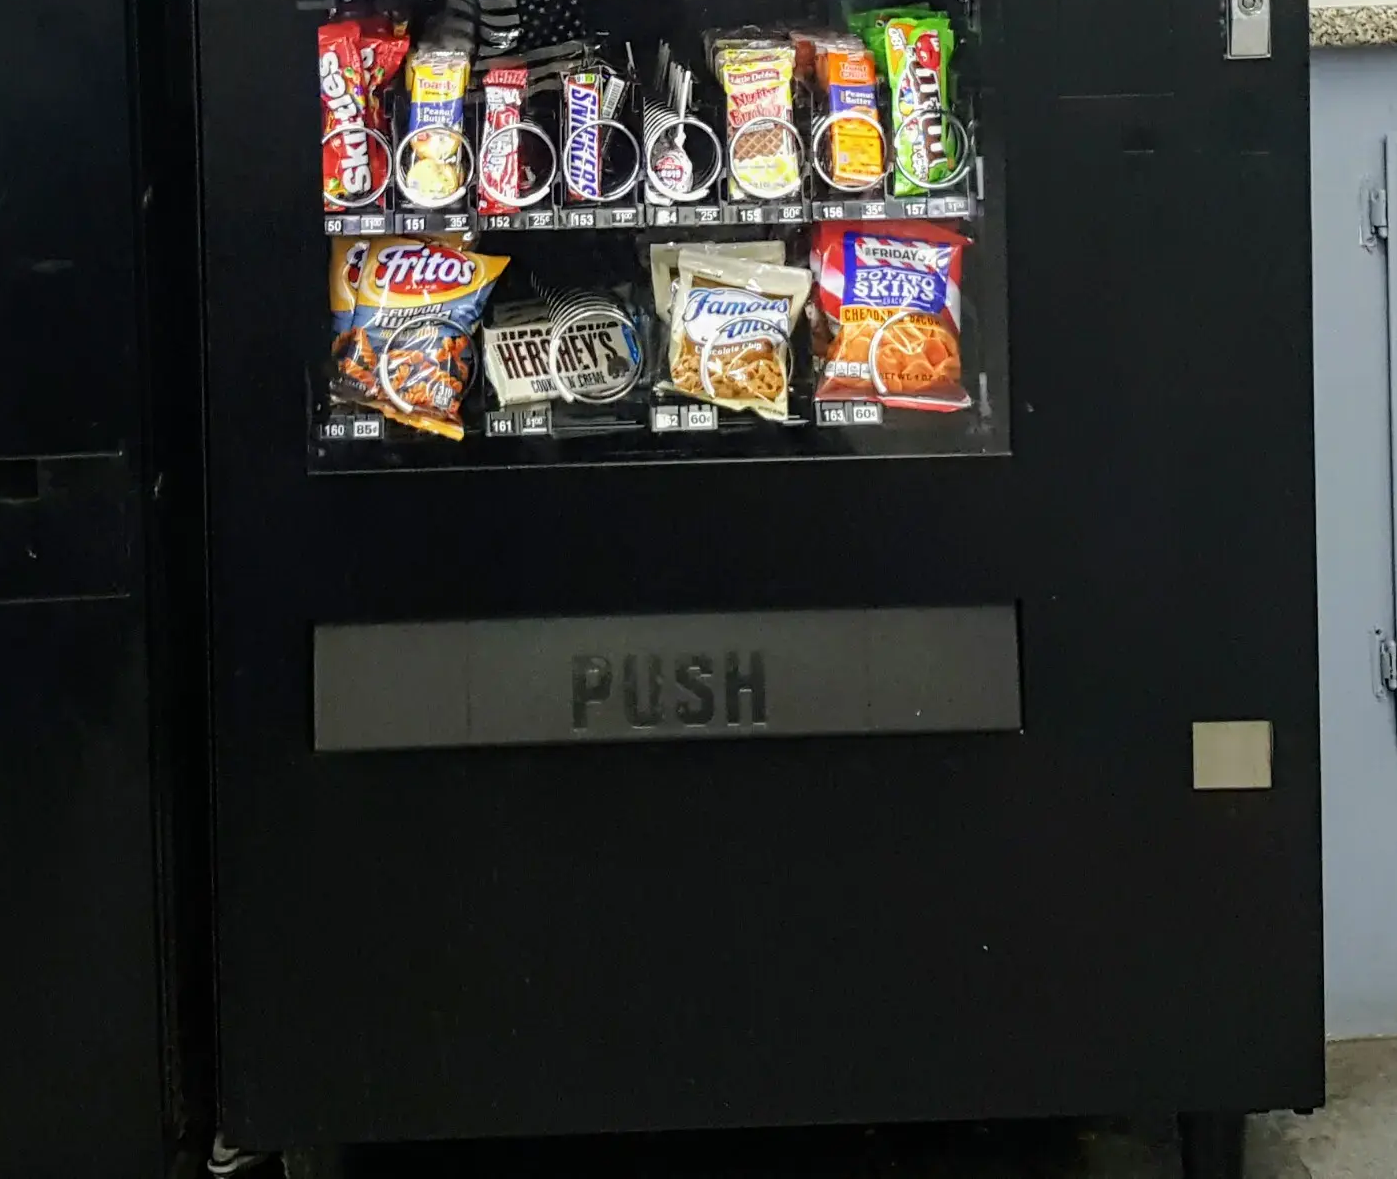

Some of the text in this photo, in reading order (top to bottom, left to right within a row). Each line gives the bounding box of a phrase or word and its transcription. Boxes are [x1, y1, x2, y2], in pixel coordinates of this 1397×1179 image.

[846, 90, 875, 99] Peanut
[846, 97, 873, 105] Butter
[423, 107, 454, 116] Peanut
[320, 51, 372, 195] Skittles
[423, 115, 453, 124] Butter
[570, 87, 599, 199] SNICKERS
[406, 219, 425, 230] 151
[489, 217, 510, 228] 152
[377, 244, 476, 285] Fritos
[856, 270, 935, 290] POTATO
[854, 280, 934, 301] SKINS
[389, 304, 442, 318] FLAVOR
[682, 289, 790, 322] Famous
[694, 340, 762, 357] Cocolate Chip
[690, 413, 712, 425] 60¢
[824, 408, 876, 421] 163 60¢
[324, 423, 378, 436] 160 85¢
[493, 421, 513, 432] 161
[571, 650, 767, 732] PUSH
